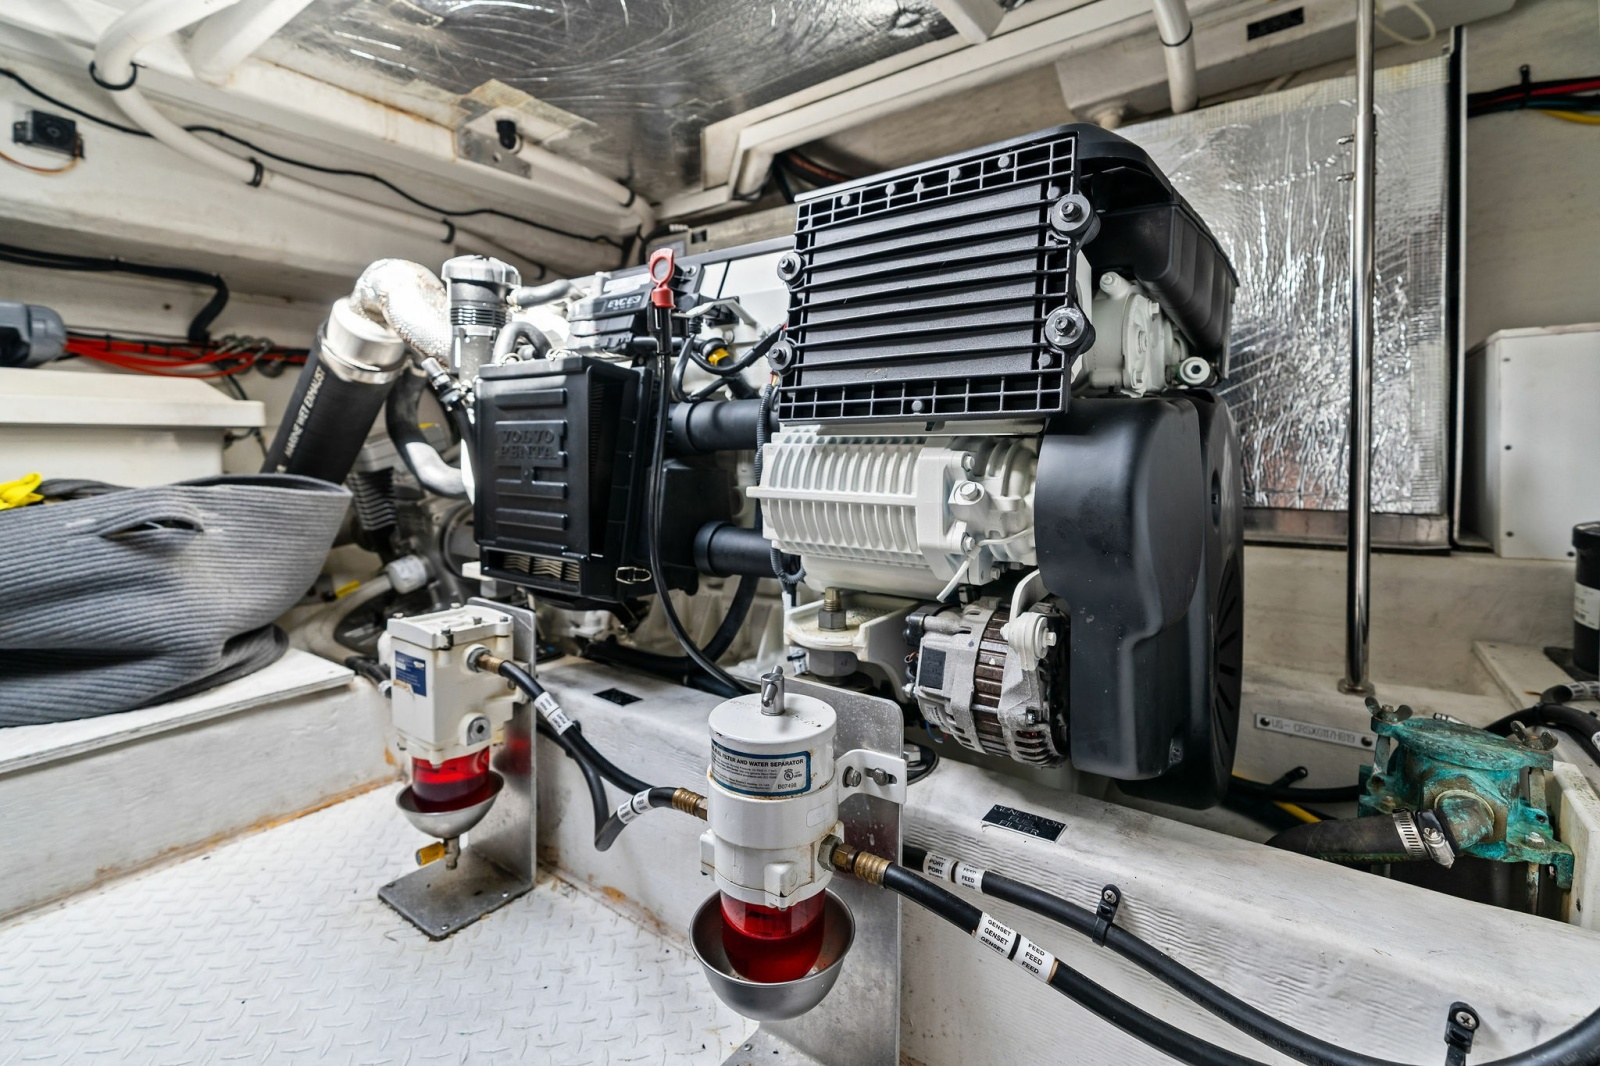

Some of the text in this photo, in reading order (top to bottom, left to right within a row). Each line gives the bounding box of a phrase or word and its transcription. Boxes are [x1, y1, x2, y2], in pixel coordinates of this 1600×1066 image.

[296, 404, 310, 426] WET
[303, 364, 326, 409] EXHAUST
[501, 429, 555, 445] VOLVO
[500, 445, 558, 461] PENTA
[737, 757, 748, 766] AND
[770, 759, 804, 767] SEPARATOR
[994, 805, 1064, 829] GENERATOR
[1008, 815, 1035, 828] FUEL
[998, 819, 1040, 836] FILTER
[927, 865, 943, 875] PORT
[928, 858, 945, 868] PORT
[961, 874, 975, 884] FEED
[987, 919, 1012, 937] GENSET
[984, 927, 1009, 946] GENSET
[980, 936, 1006, 954] GENSET
[1027, 943, 1046, 956] FEED
[1024, 951, 1043, 966] FEED
[1021, 960, 1040, 975] FEED
